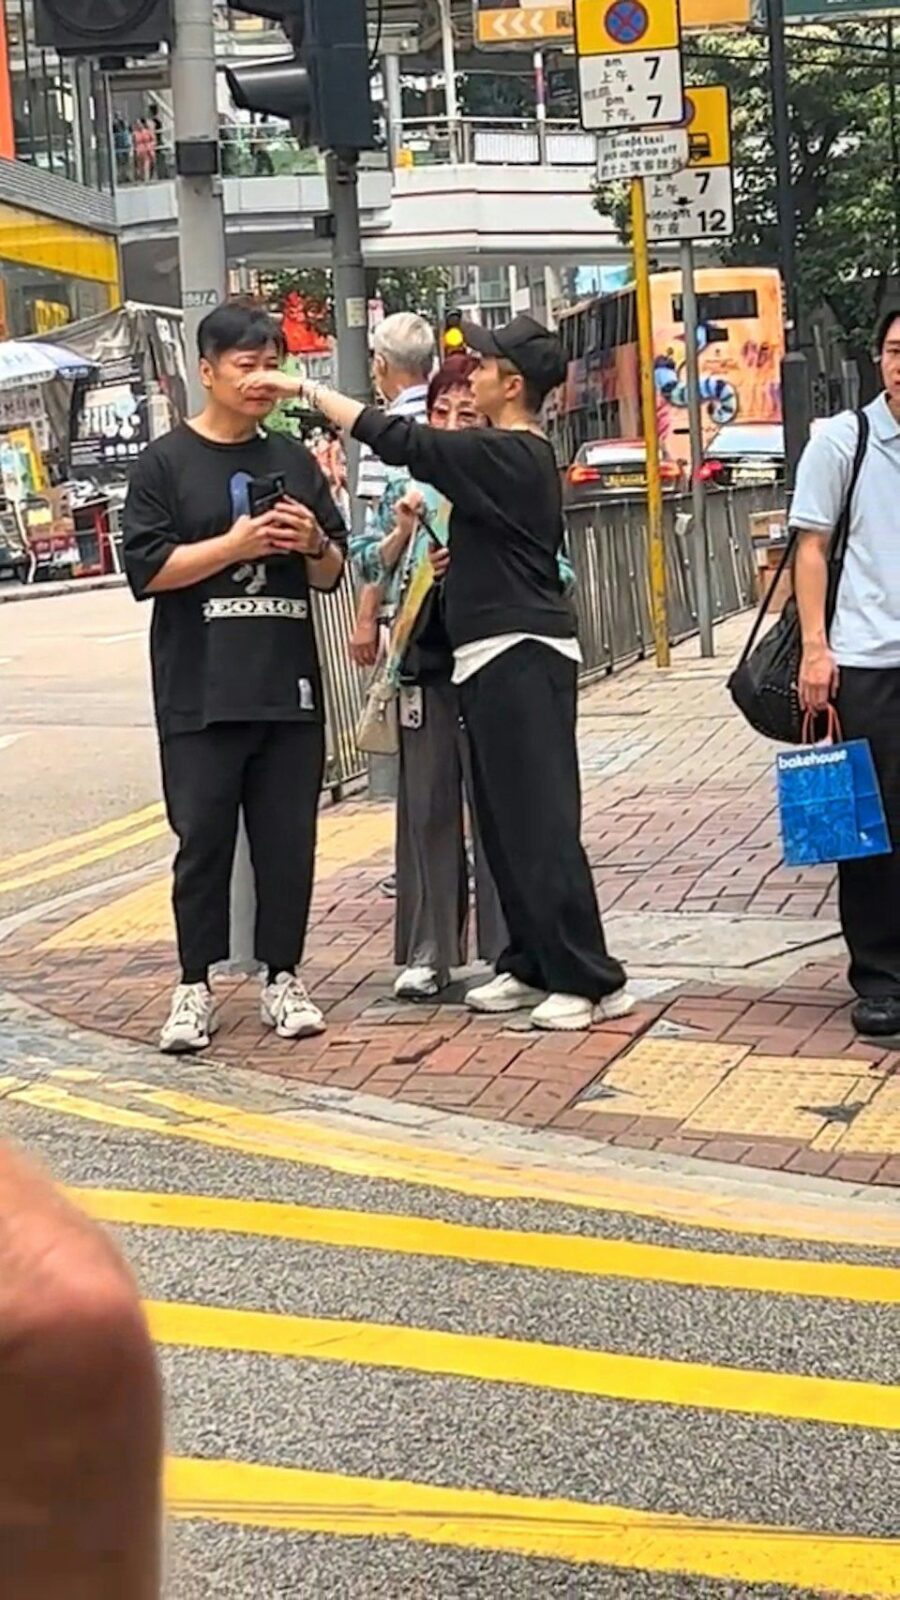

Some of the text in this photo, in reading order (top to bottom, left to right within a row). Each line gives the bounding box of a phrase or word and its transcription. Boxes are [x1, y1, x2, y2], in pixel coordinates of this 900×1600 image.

[604, 58, 622, 67] am
[644, 56, 660, 80] 7
[601, 69, 627, 84] 上午
[606, 96, 624, 107] pm
[646, 95, 662, 118] 7
[601, 108, 629, 122] 下午
[644, 134, 664, 145] taxi
[661, 143, 677, 154] off
[653, 183, 678, 198] 上午
[694, 172, 710, 194] 7
[697, 209, 726, 232] 12
[779, 749, 847, 769] bakehouse
